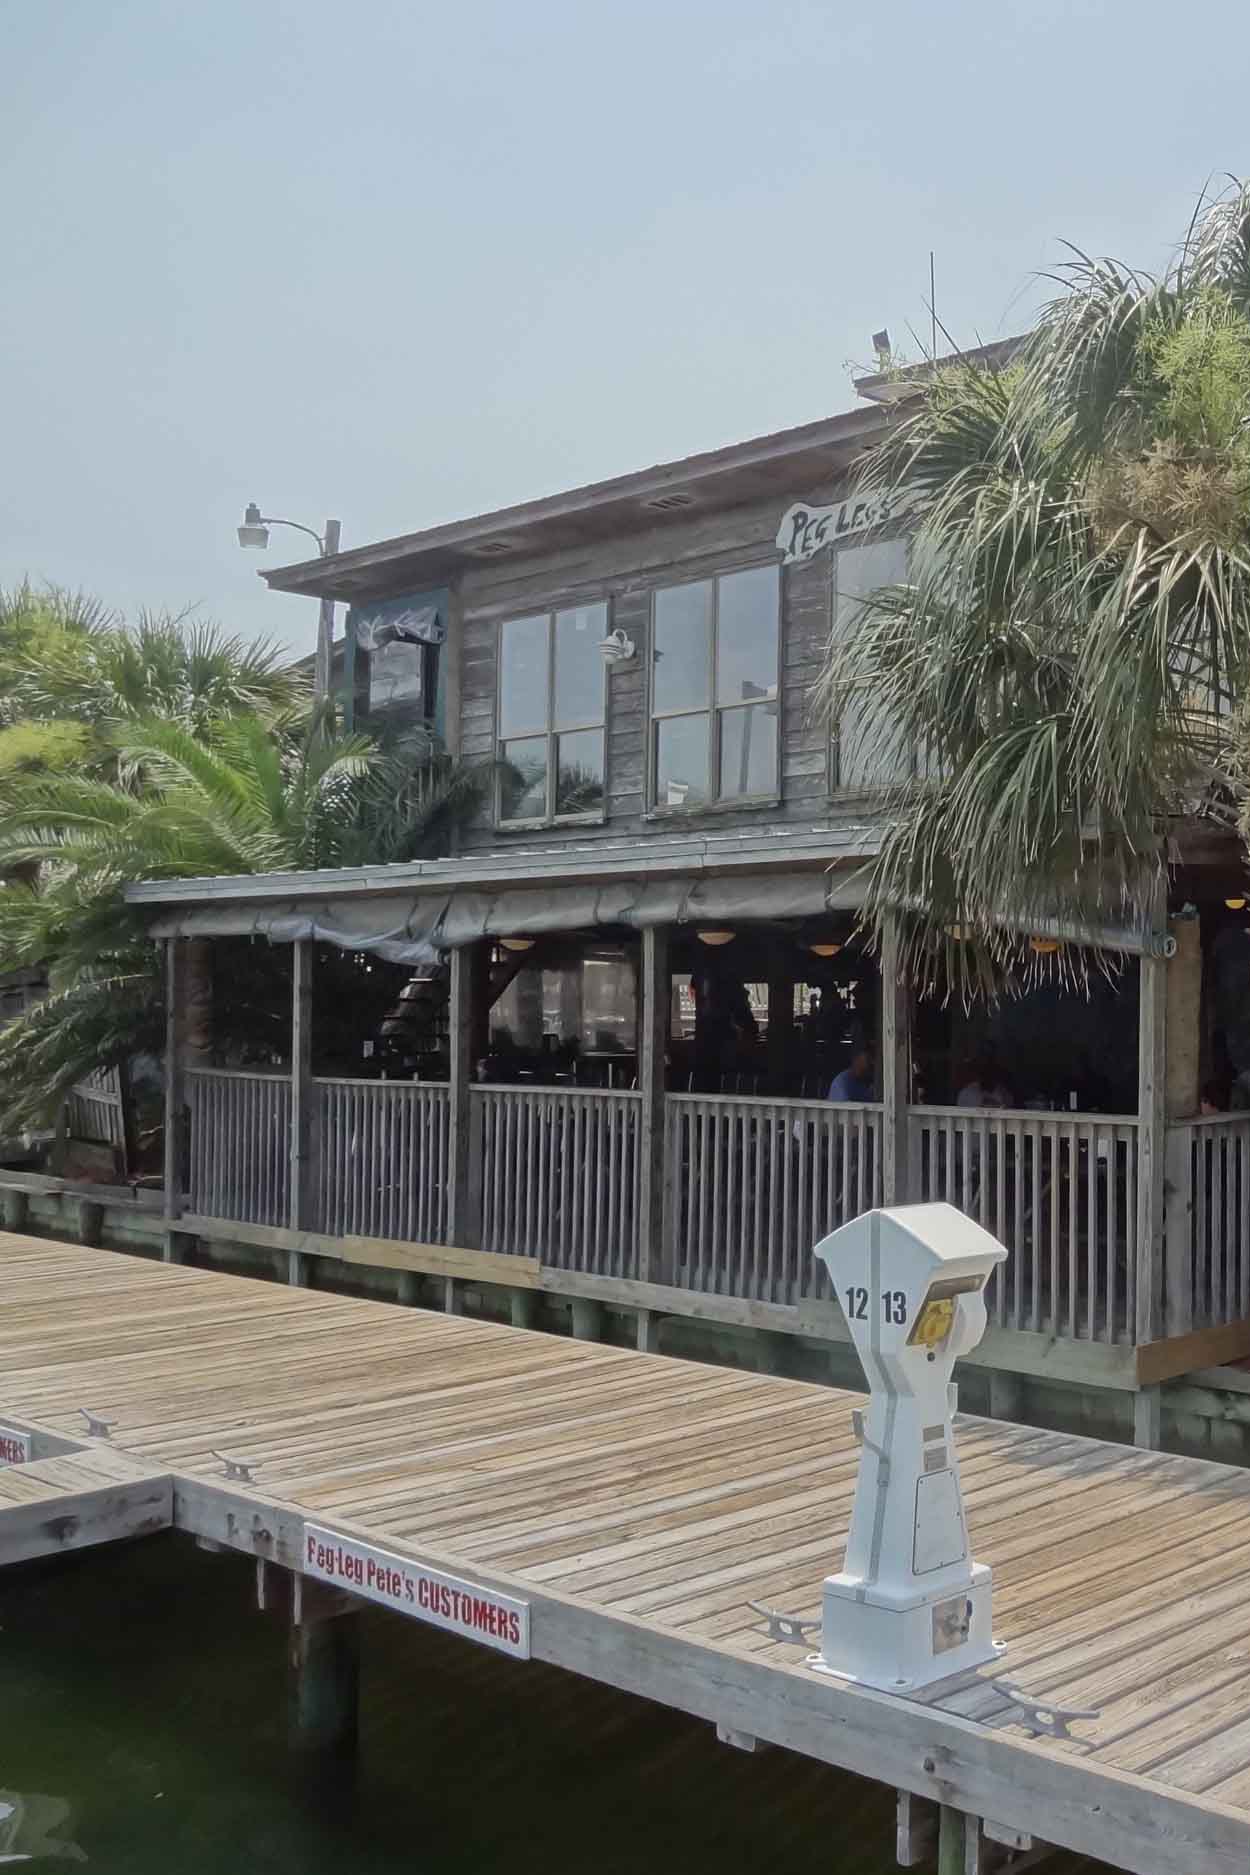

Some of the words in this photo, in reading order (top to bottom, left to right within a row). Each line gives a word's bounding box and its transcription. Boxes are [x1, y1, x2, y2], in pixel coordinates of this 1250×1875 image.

[845, 1287, 869, 1320] 12
[881, 1290, 906, 1325] 13
[366, 1557, 414, 1603] Pete's
[418, 1577, 520, 1645] CUSTOMERS
